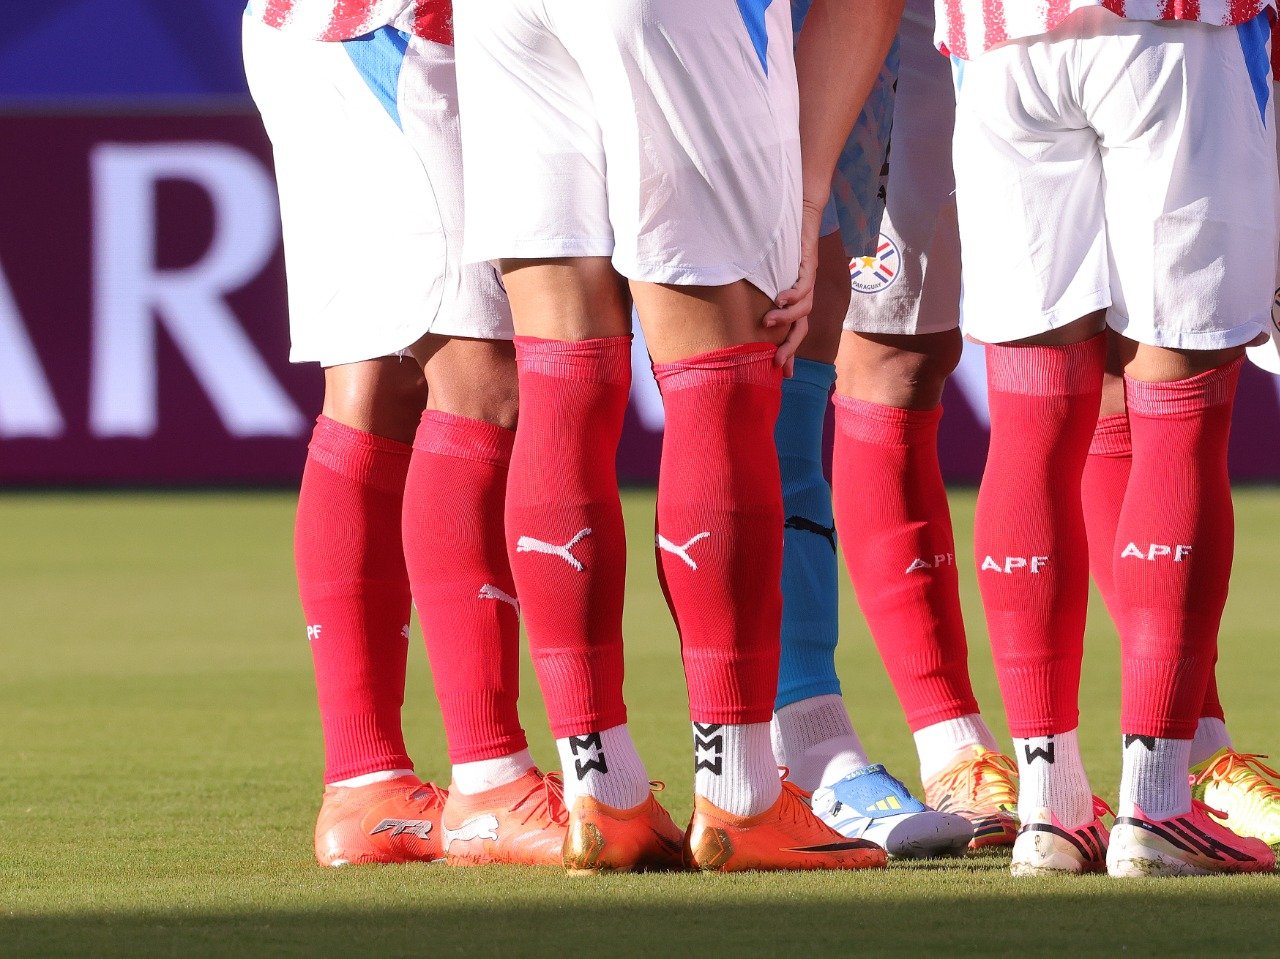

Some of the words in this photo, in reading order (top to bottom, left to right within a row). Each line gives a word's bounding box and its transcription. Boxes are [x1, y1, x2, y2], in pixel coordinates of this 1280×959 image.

[852, 280, 882, 291] PARAGUAY
[905, 542, 953, 574] APF
[1121, 542, 1192, 562] APF
[981, 555, 1049, 574] APF
